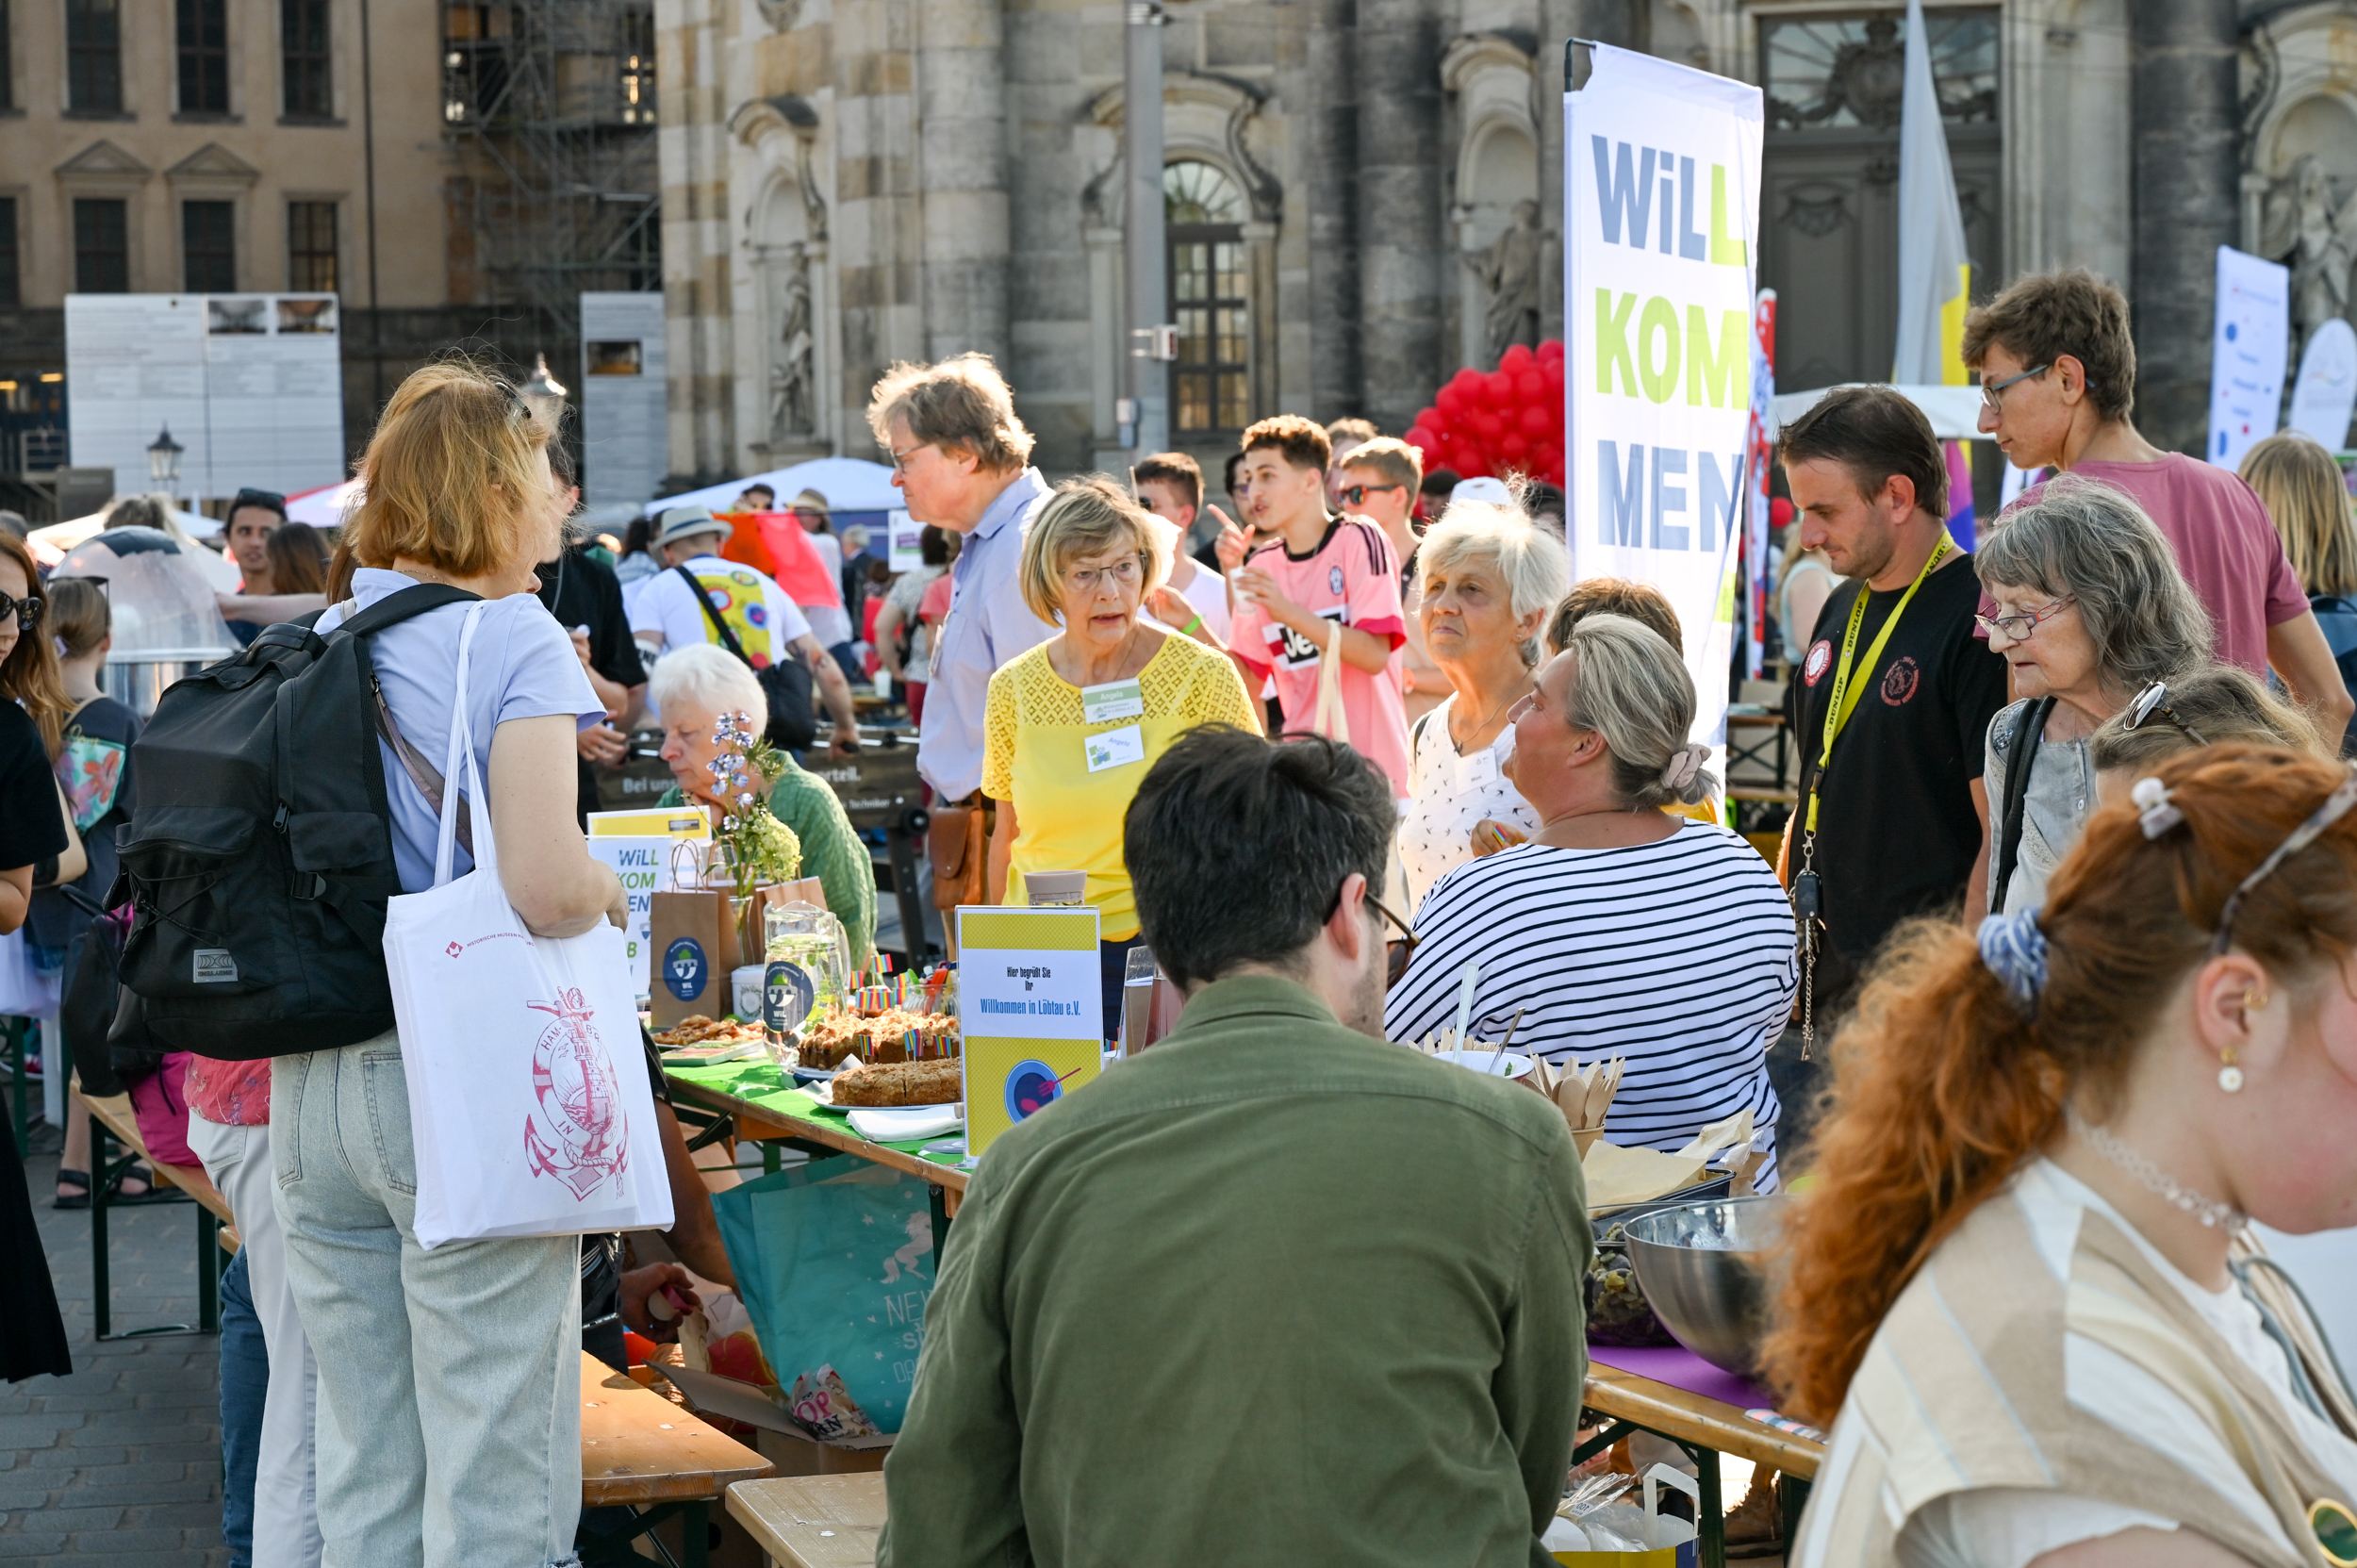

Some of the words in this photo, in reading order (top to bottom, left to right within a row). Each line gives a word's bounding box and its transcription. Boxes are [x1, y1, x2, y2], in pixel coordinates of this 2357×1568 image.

[1591, 134, 1748, 268] WiLL
[1595, 287, 1750, 411] KOM
[1597, 439, 1745, 553] MEN
[1848, 601, 1864, 650] DUNLOP
[1283, 627, 1321, 657] Je
[1829, 676, 1844, 725] DUNLOP
[622, 777, 647, 794] Bei
[619, 849, 659, 867] WiLL
[626, 896, 651, 912] EN
[467, 934, 496, 948] HISTORISCHE
[1007, 966, 1018, 978] Hier
[1019, 966, 1041, 979] begrüßt
[1042, 966, 1051, 979] Sie
[1025, 980, 1034, 991] Ihr
[981, 998, 1026, 1015] Willkommen
[1029, 999, 1036, 1015] in
[1038, 999, 1064, 1015] Löbtau
[1065, 999, 1081, 1016] e.V.
[557, 1120, 574, 1135] IN
